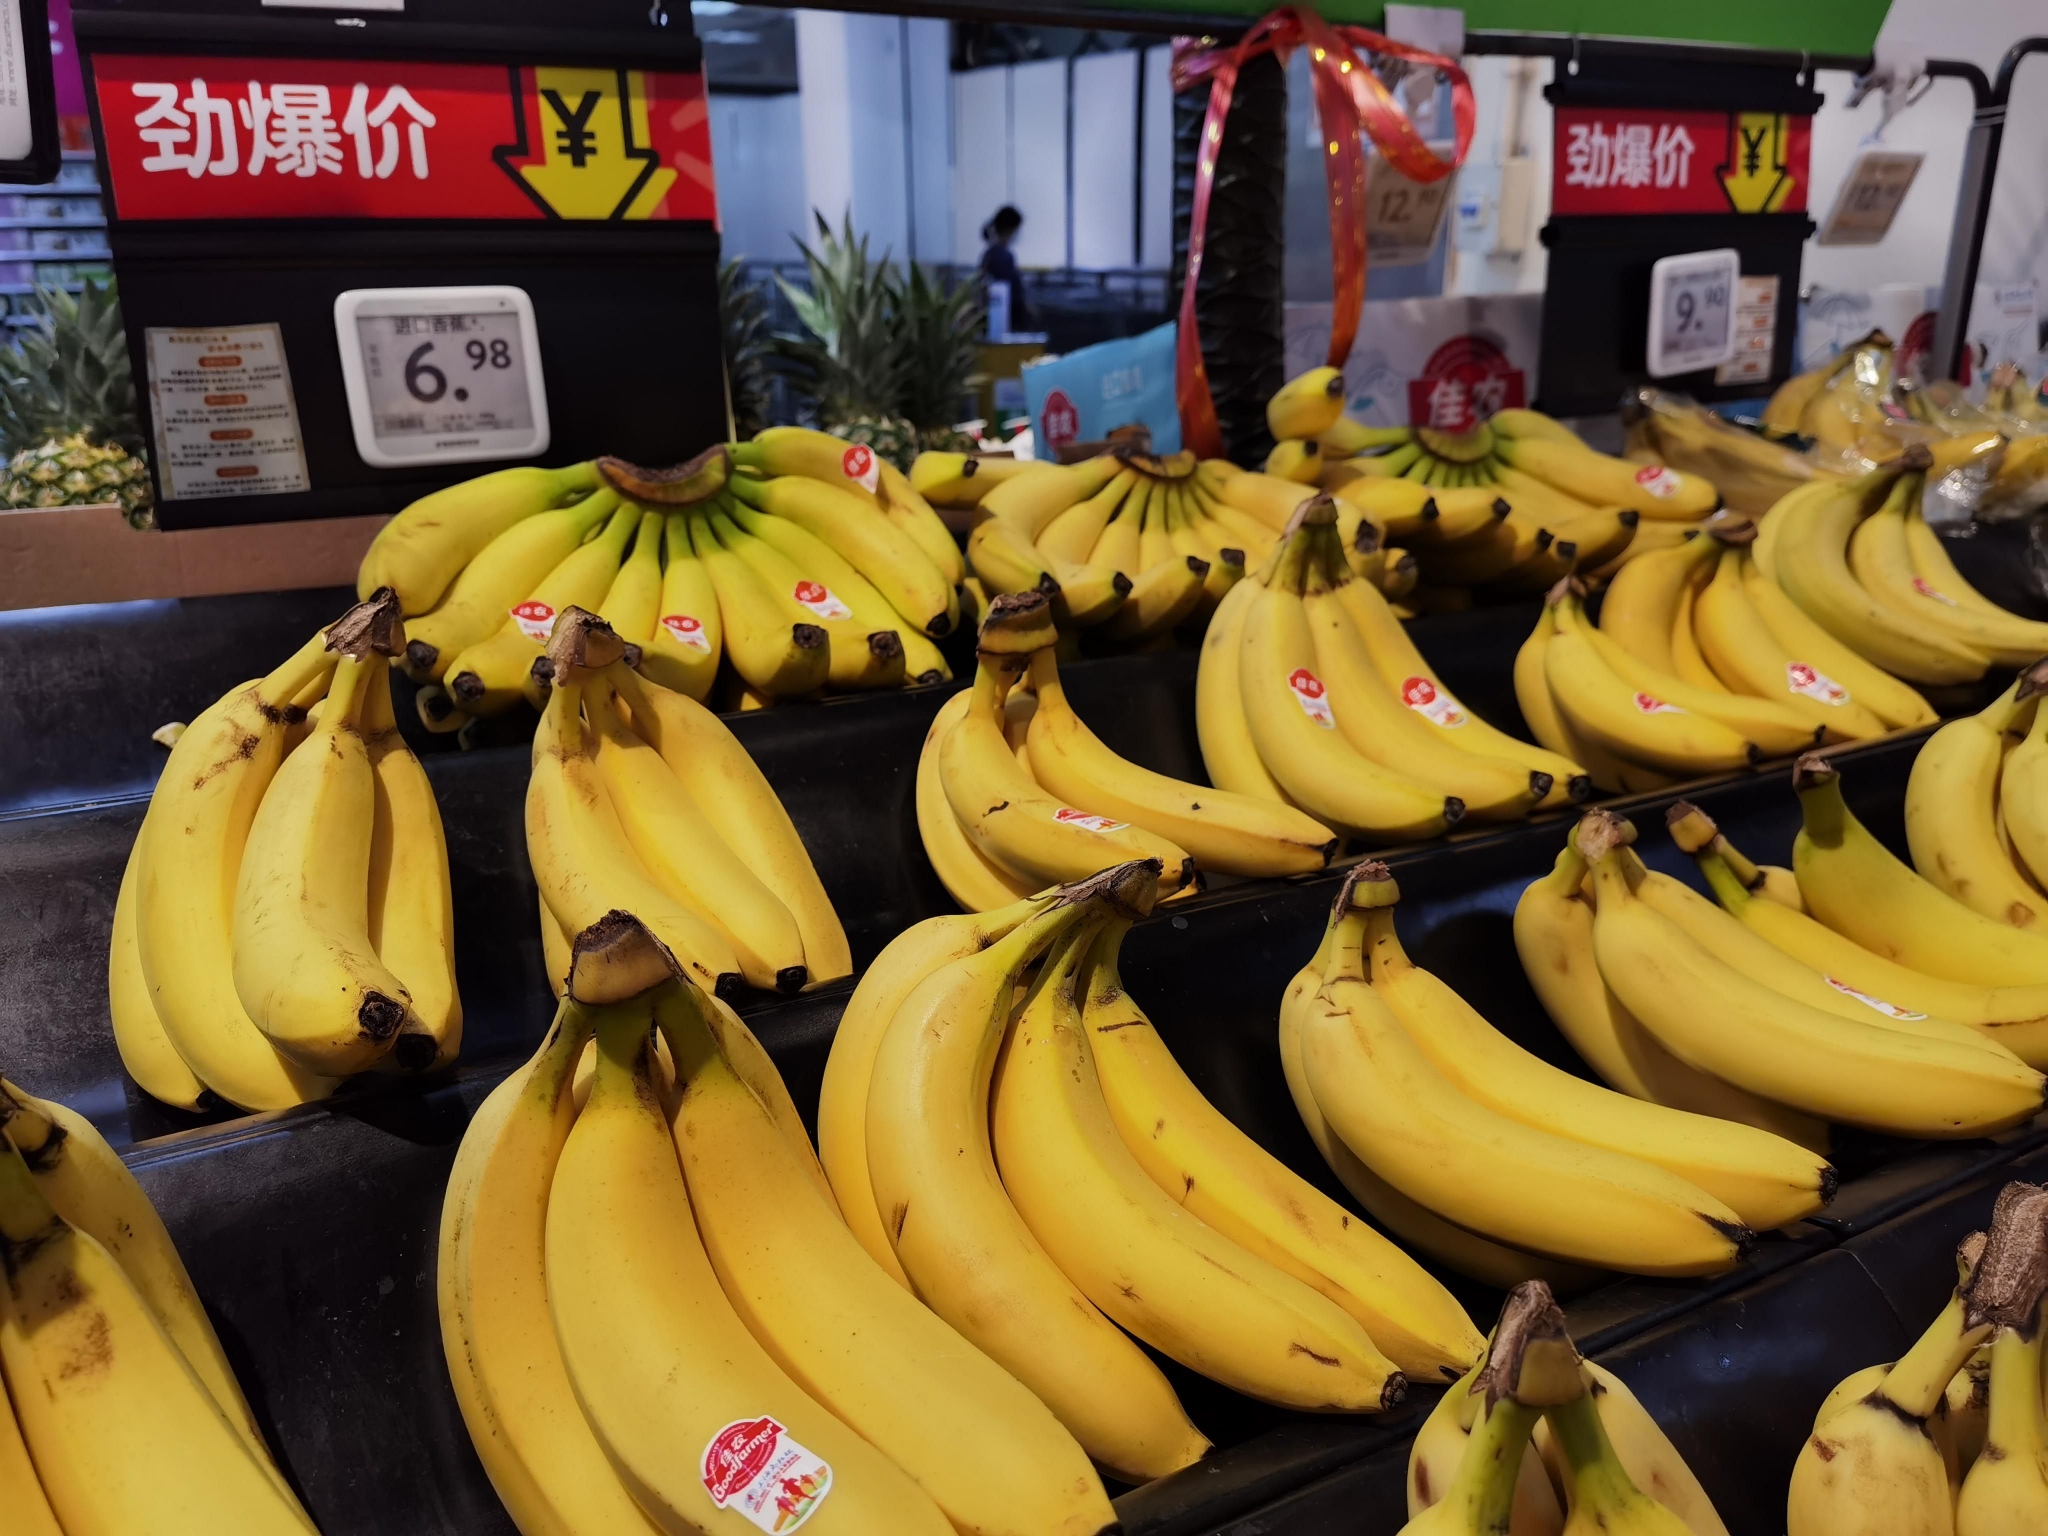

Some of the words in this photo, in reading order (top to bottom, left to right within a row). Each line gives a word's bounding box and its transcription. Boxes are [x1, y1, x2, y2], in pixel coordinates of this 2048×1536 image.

[132, 79, 436, 179] 劲爆价
[1566, 121, 1695, 188] 劲爆价
[720, 1433, 748, 1467] 佳农
